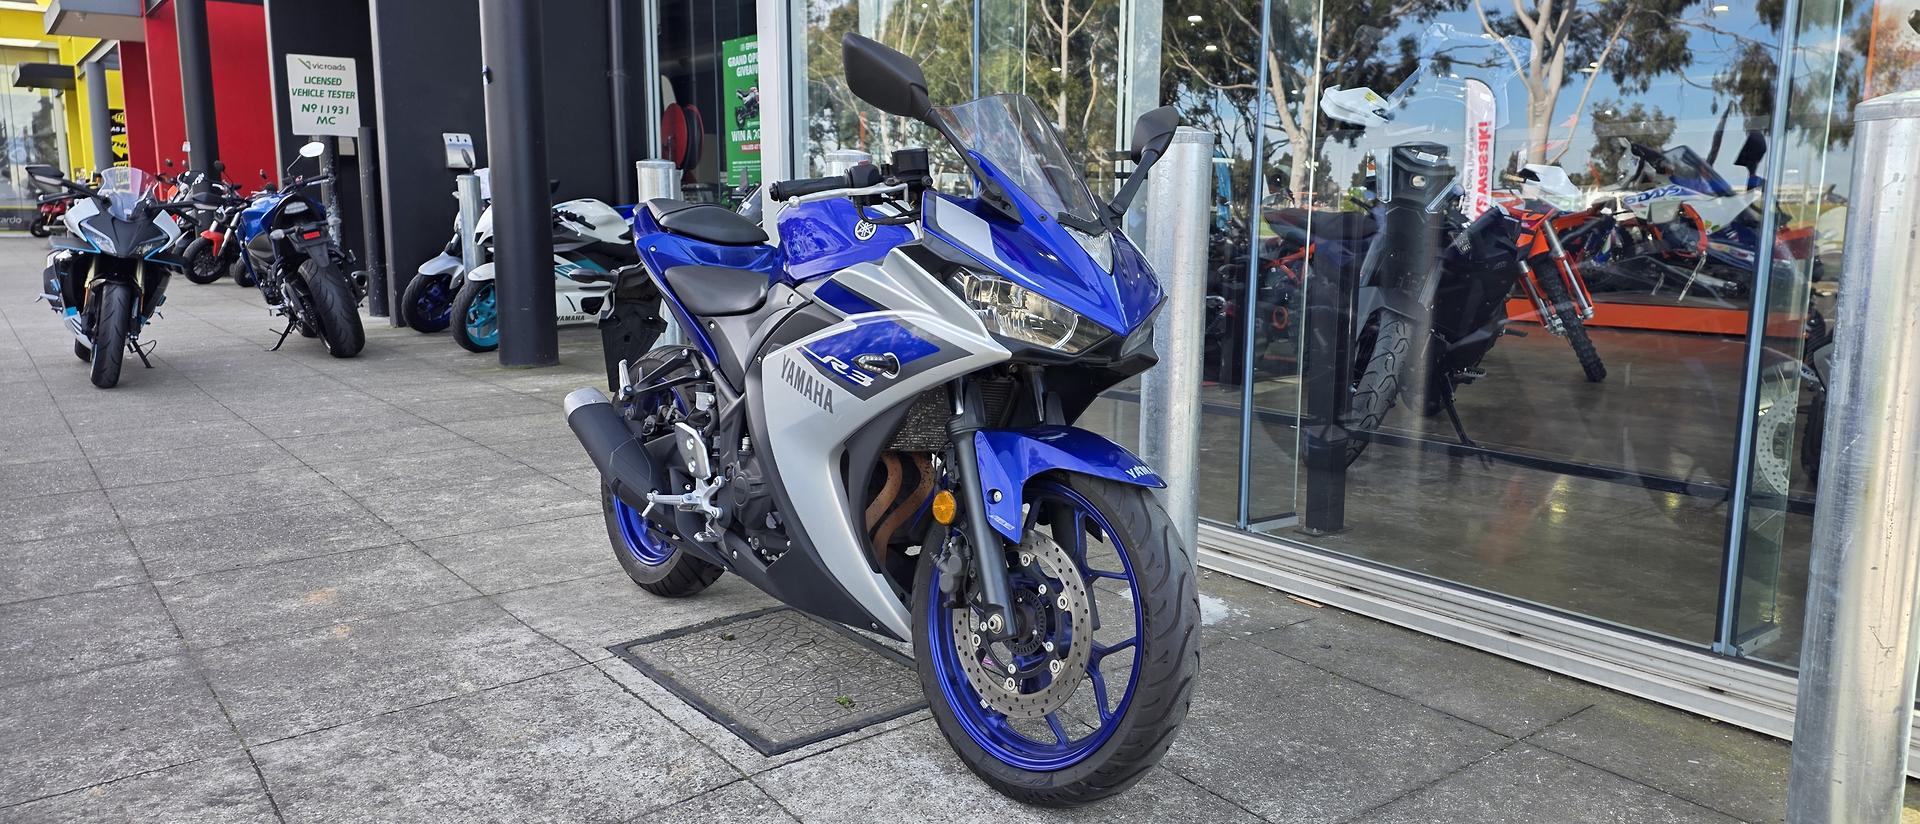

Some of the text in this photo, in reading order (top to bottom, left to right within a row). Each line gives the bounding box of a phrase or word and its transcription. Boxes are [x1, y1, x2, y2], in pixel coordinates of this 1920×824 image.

[312, 62, 346, 71] vicroads
[304, 76, 342, 86] LICENSED
[291, 88, 356, 99] VEHICLE TESTER
[320, 105, 349, 115] 11931
[316, 116, 336, 125] MC
[731, 130, 746, 142] WIN
[806, 348, 874, 387] R3
[781, 354, 834, 414] YAMAHA
